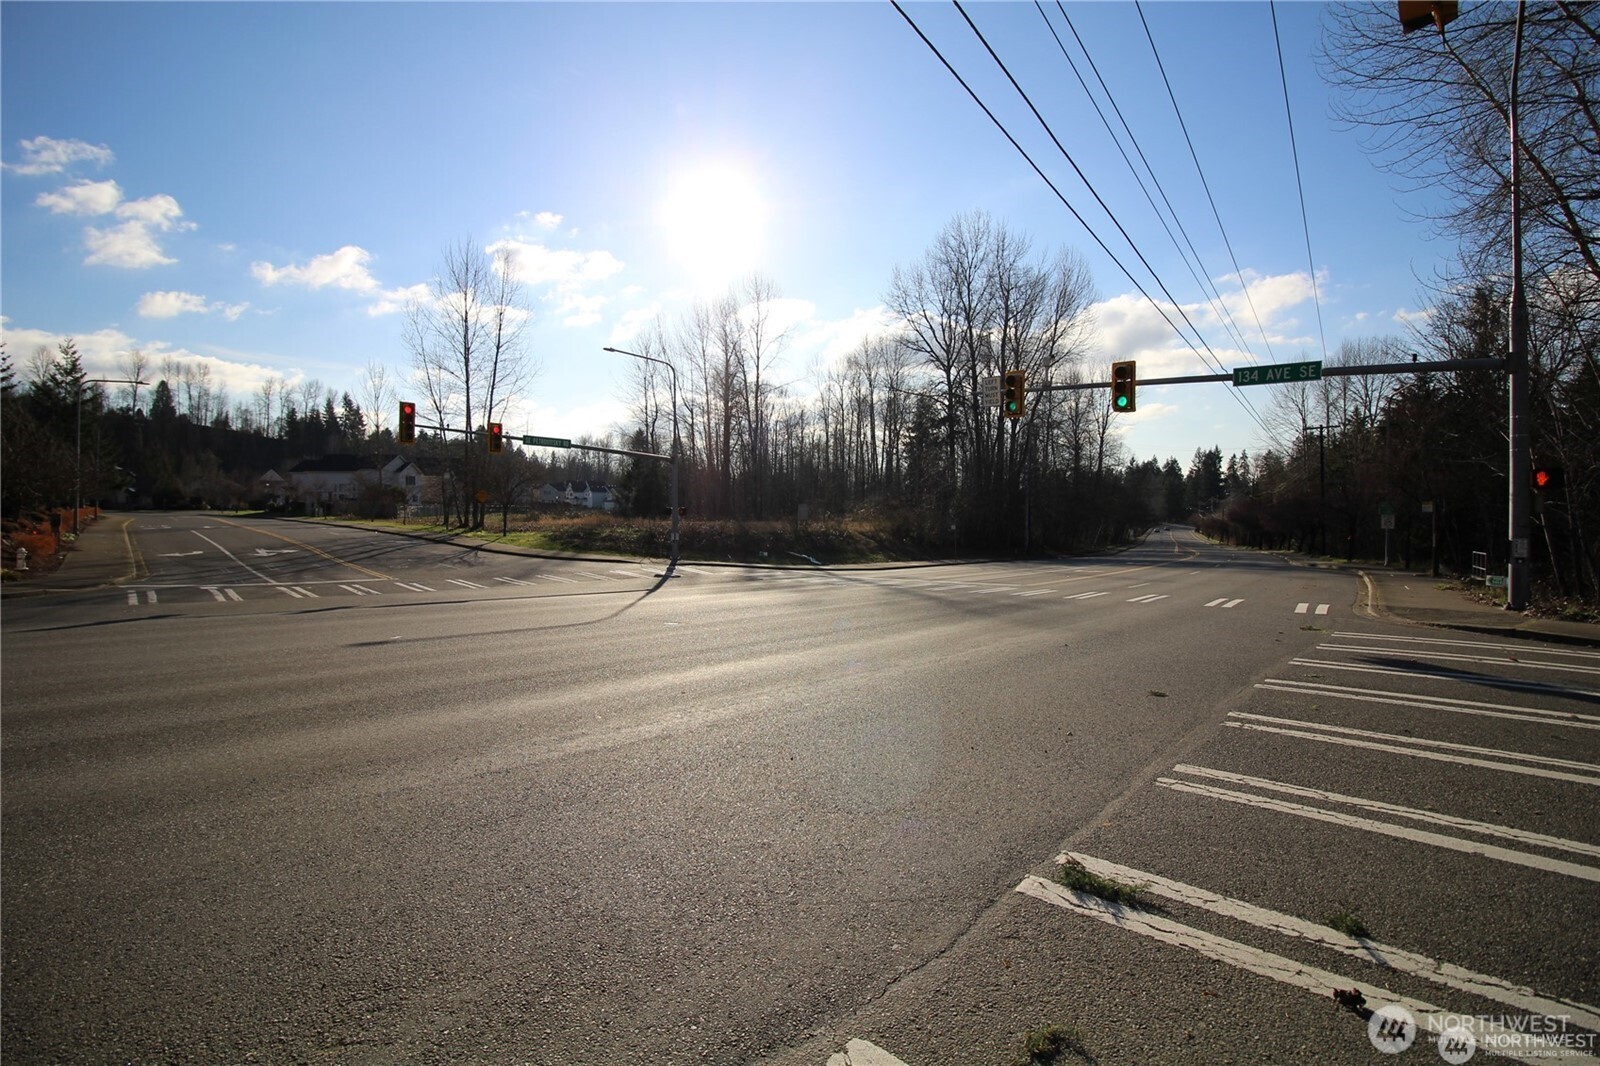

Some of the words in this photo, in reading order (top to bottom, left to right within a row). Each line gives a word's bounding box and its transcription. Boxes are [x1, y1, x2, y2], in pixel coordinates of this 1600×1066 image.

[1238, 370, 1259, 383] 134
[1266, 367, 1291, 381] AVE
[1299, 364, 1316, 378] SE
